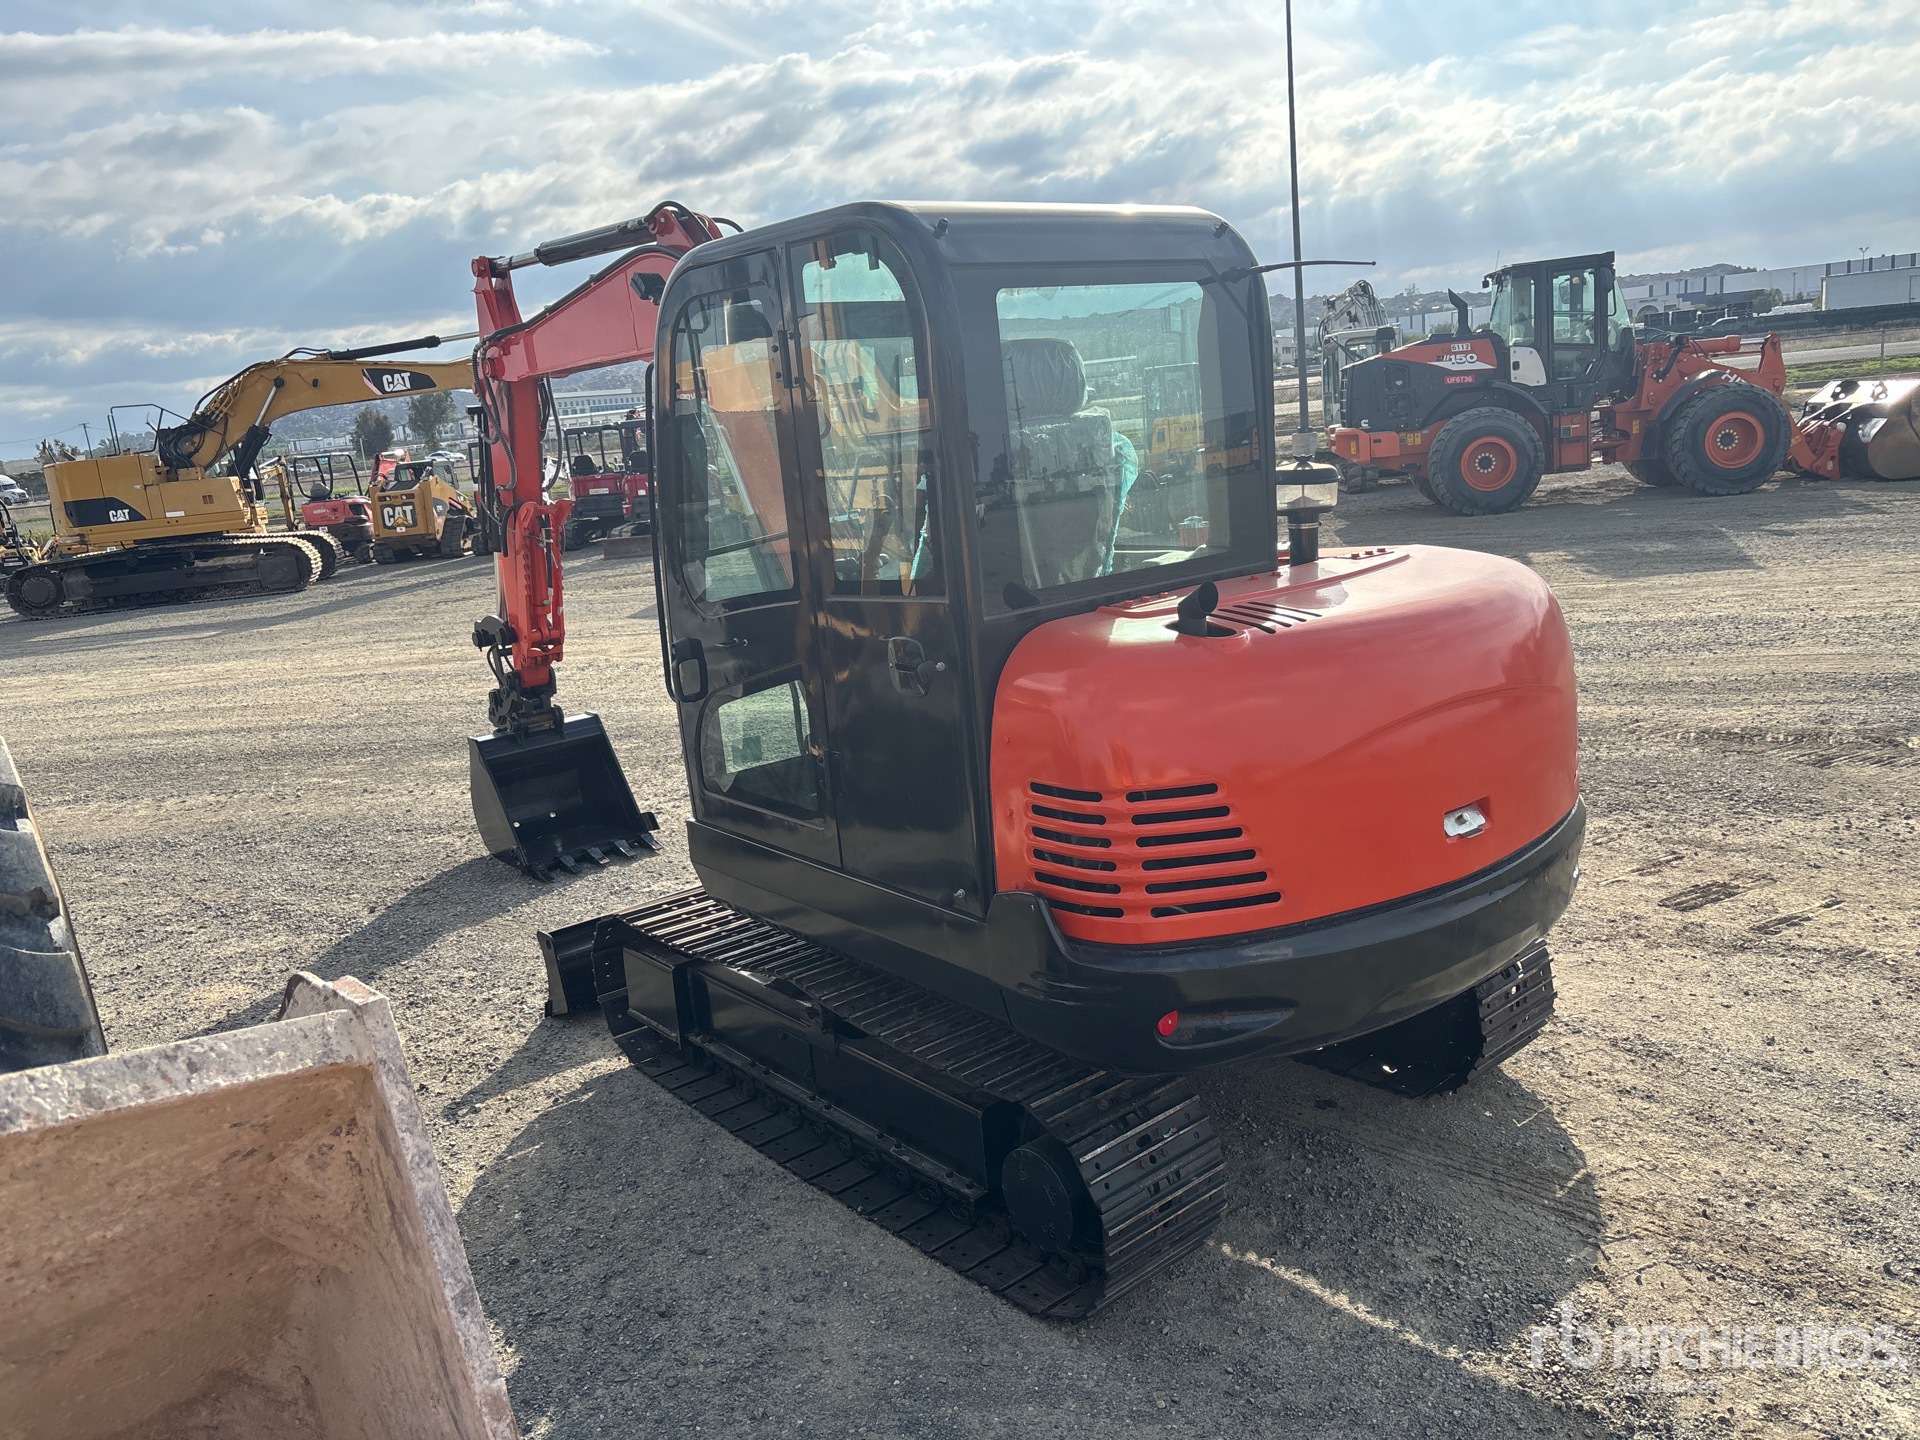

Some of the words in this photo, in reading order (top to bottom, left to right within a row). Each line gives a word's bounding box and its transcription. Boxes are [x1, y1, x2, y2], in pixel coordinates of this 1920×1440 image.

[382, 372, 411, 392] CAT
[109, 509, 130, 522] CAT
[383, 505, 413, 527] CAT
